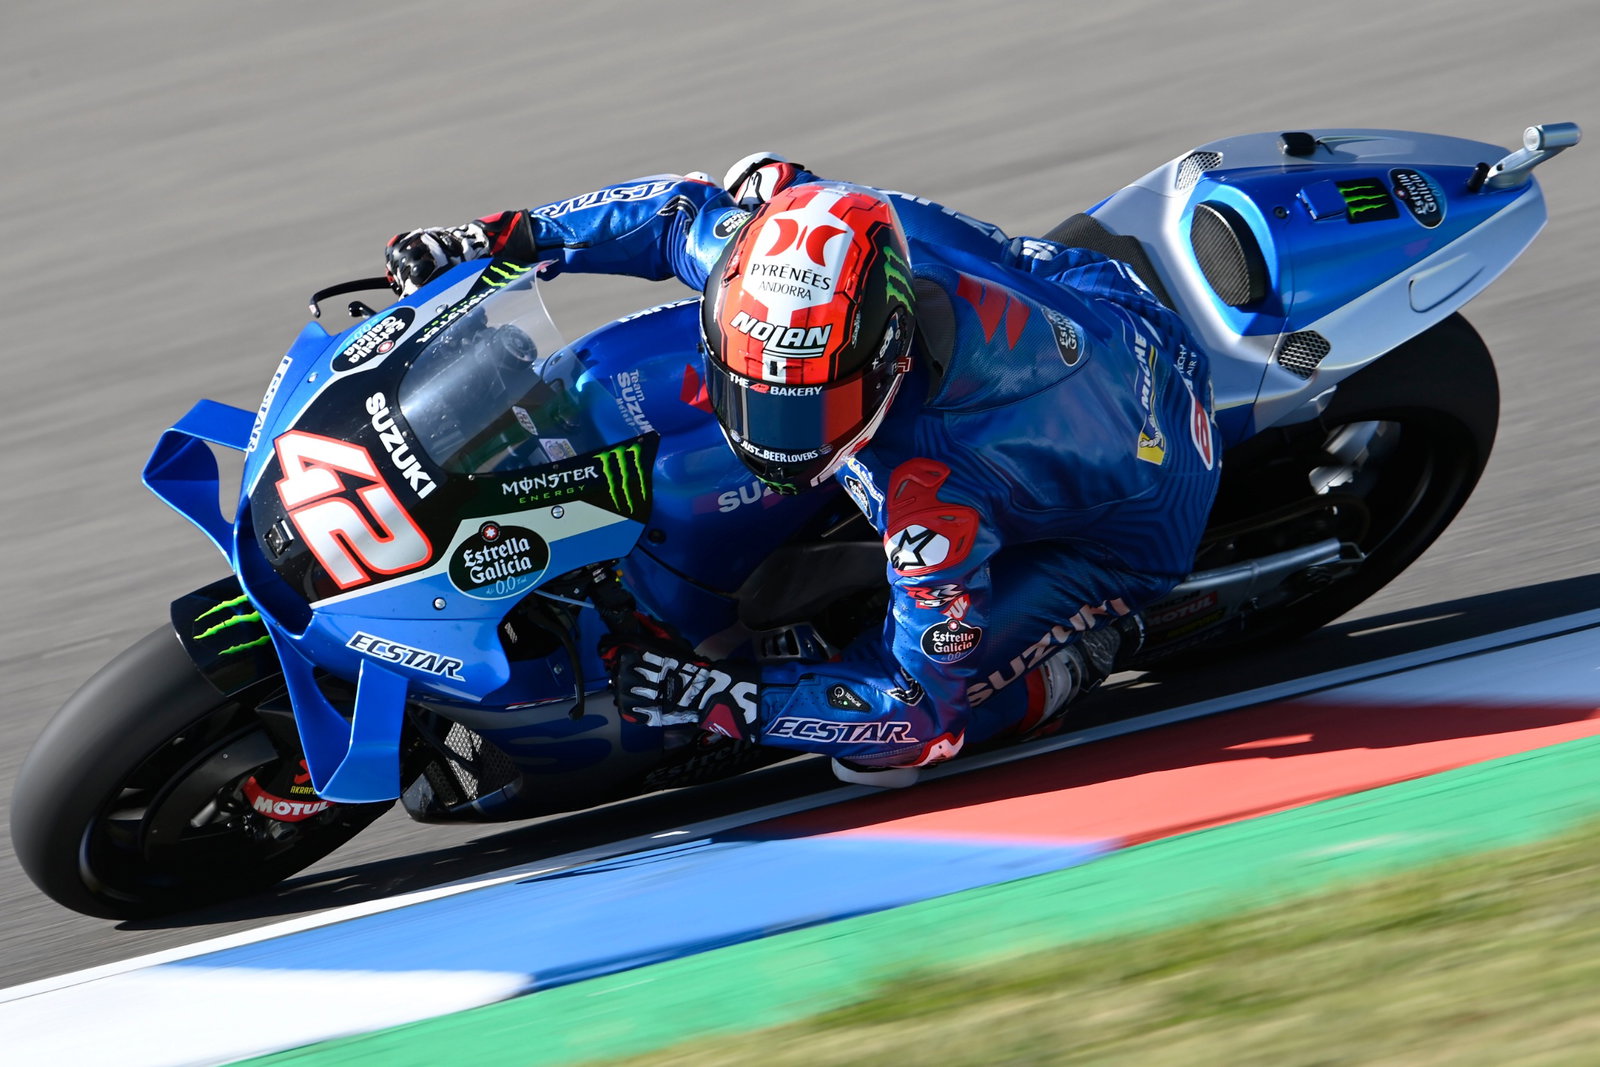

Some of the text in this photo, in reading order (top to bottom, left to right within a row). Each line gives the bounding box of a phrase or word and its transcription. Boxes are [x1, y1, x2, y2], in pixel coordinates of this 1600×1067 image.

[759, 280, 812, 301] ANDORRA
[729, 310, 833, 355] NOLAN
[629, 369, 645, 402] Team
[729, 372, 750, 389] THE
[770, 385, 823, 397] BAKERY
[617, 372, 656, 434] SUZUK
[366, 392, 437, 499] SUZUKI
[741, 440, 761, 456] JUST
[501, 465, 599, 496] MONSTER
[519, 485, 585, 504] ENERGY
[274, 429, 433, 590] 42
[463, 537, 531, 568] Estrella
[470, 554, 533, 584] Galicia
[932, 630, 974, 643] Estrella
[933, 640, 972, 653] Galicia
[345, 630, 466, 682] ECSTAR
[766, 716, 919, 744] ECSTAR
[254, 795, 329, 816] MOTUL
